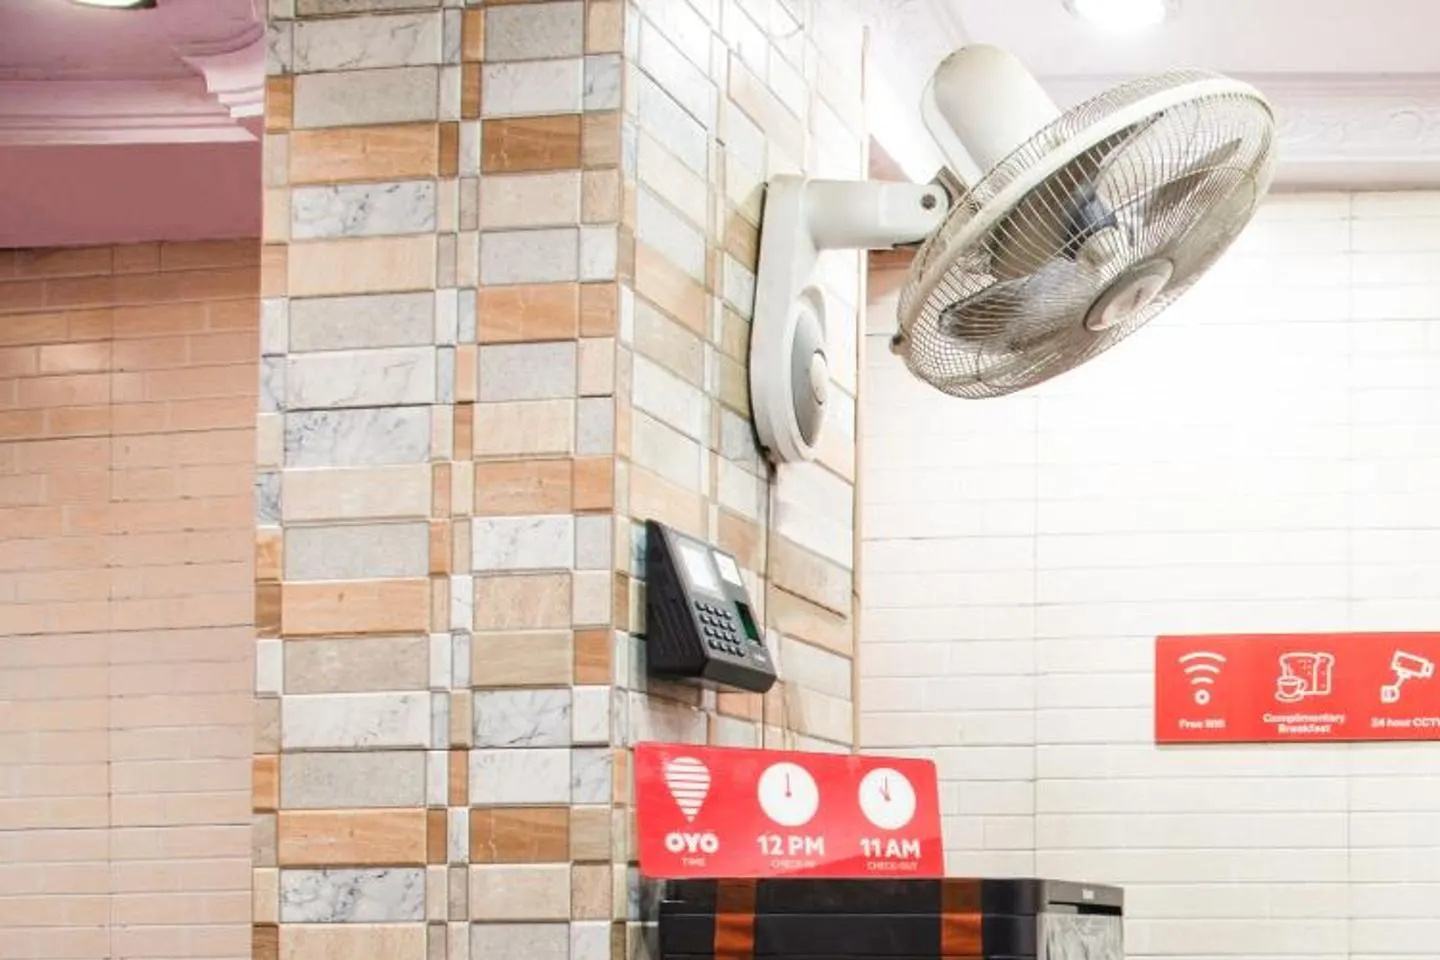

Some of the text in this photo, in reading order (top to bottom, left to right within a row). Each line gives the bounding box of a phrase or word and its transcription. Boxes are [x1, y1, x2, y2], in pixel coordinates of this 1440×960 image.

[1263, 713, 1345, 724] Complimentary
[1278, 724, 1331, 733] Breakfast
[664, 832, 719, 853] OYO
[756, 835, 825, 856] 12 PM
[860, 838, 921, 858] 11 AM
